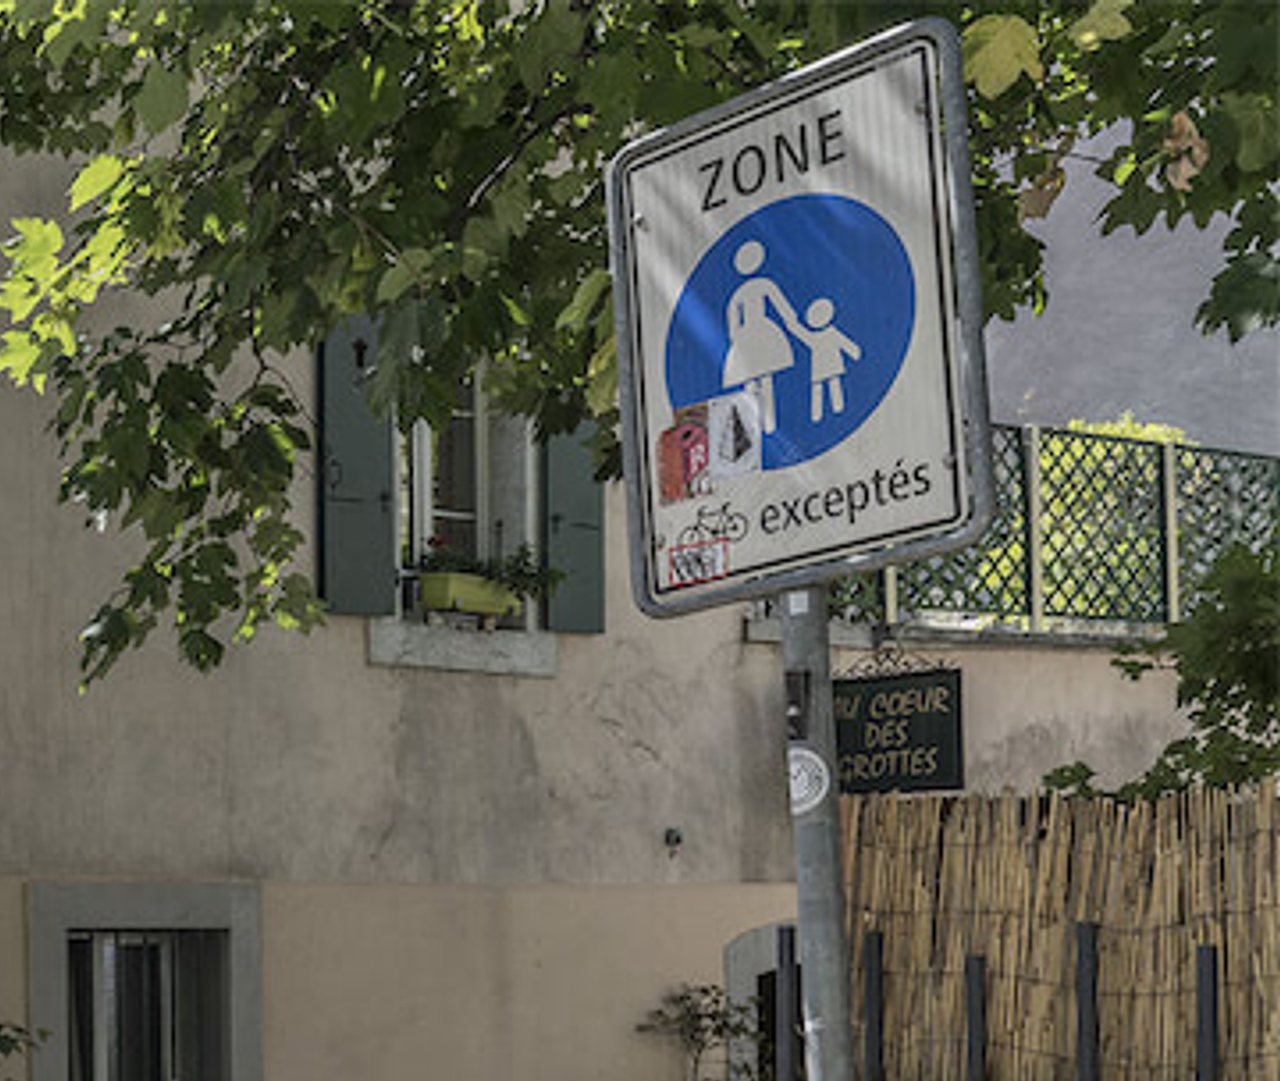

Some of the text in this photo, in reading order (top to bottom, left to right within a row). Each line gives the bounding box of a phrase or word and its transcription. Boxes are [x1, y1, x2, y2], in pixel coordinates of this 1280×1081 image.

[699, 109, 845, 213] ZONE
[760, 458, 931, 535] exceptés
[865, 720, 909, 748] DES
